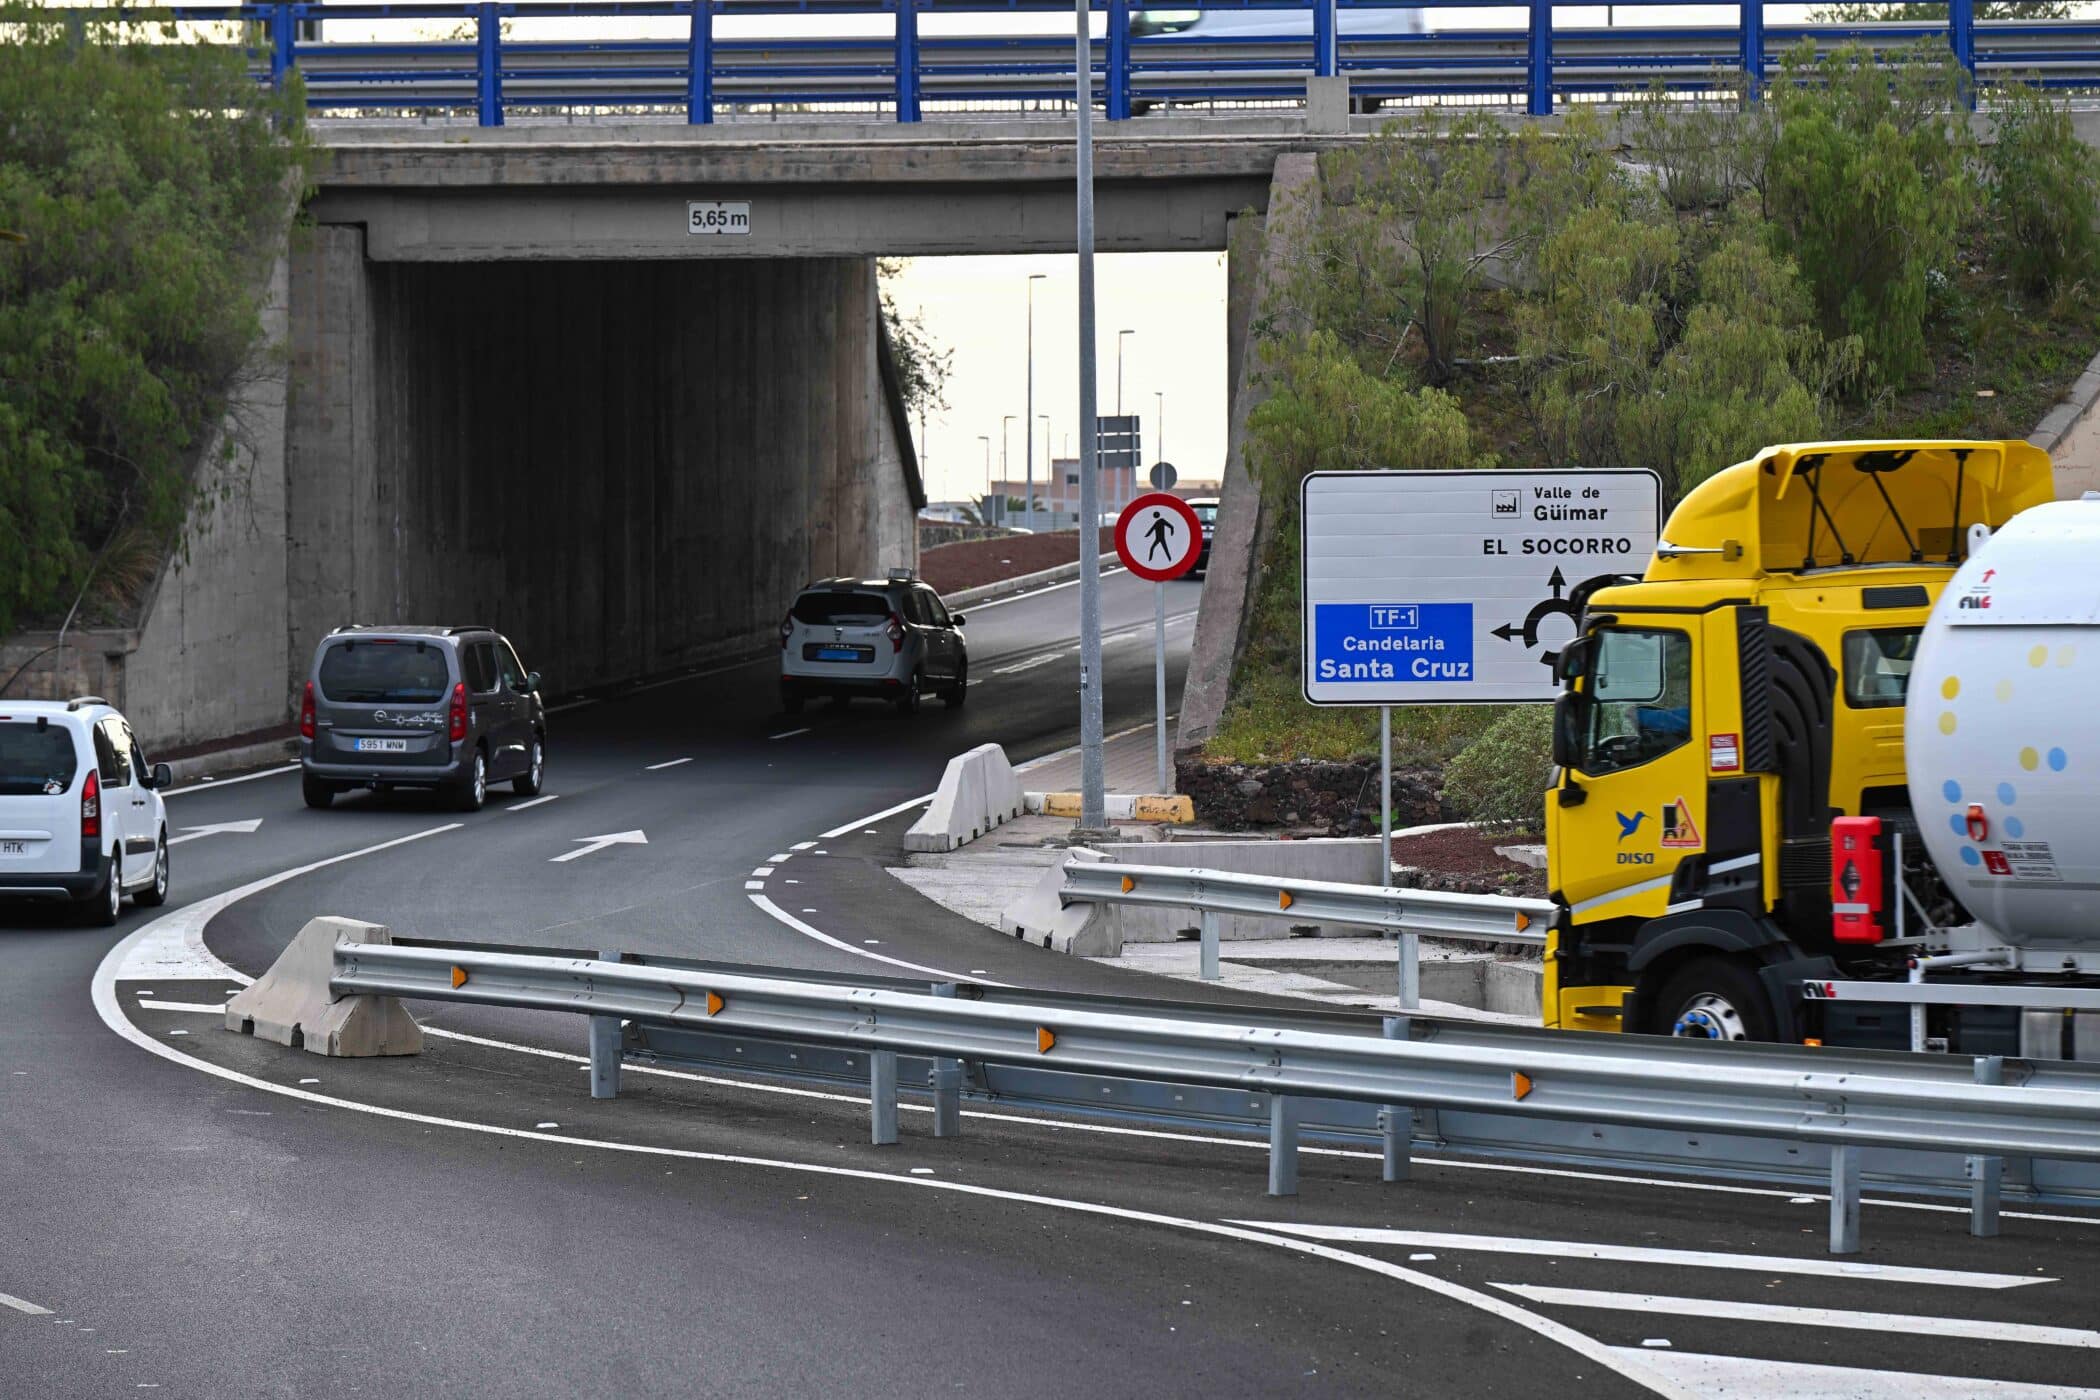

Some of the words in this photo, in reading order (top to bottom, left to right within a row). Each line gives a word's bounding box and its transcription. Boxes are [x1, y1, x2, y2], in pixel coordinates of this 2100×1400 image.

[691, 210, 727, 228] 5,65
[730, 213, 748, 226] m
[1533, 486, 1572, 499] Valle
[1581, 486, 1601, 499] de
[1533, 504, 1609, 521] Güímar
[1483, 539, 1509, 555] EL
[1521, 538, 1632, 555] SOCORRO
[1373, 609, 1416, 625] TF-1
[1342, 635, 1446, 652] Candelaria
[1319, 658, 1395, 679] Santa
[1411, 657, 1470, 679] Cruz
[360, 740, 383, 749] 5951
[3, 842, 25, 853] HTK
